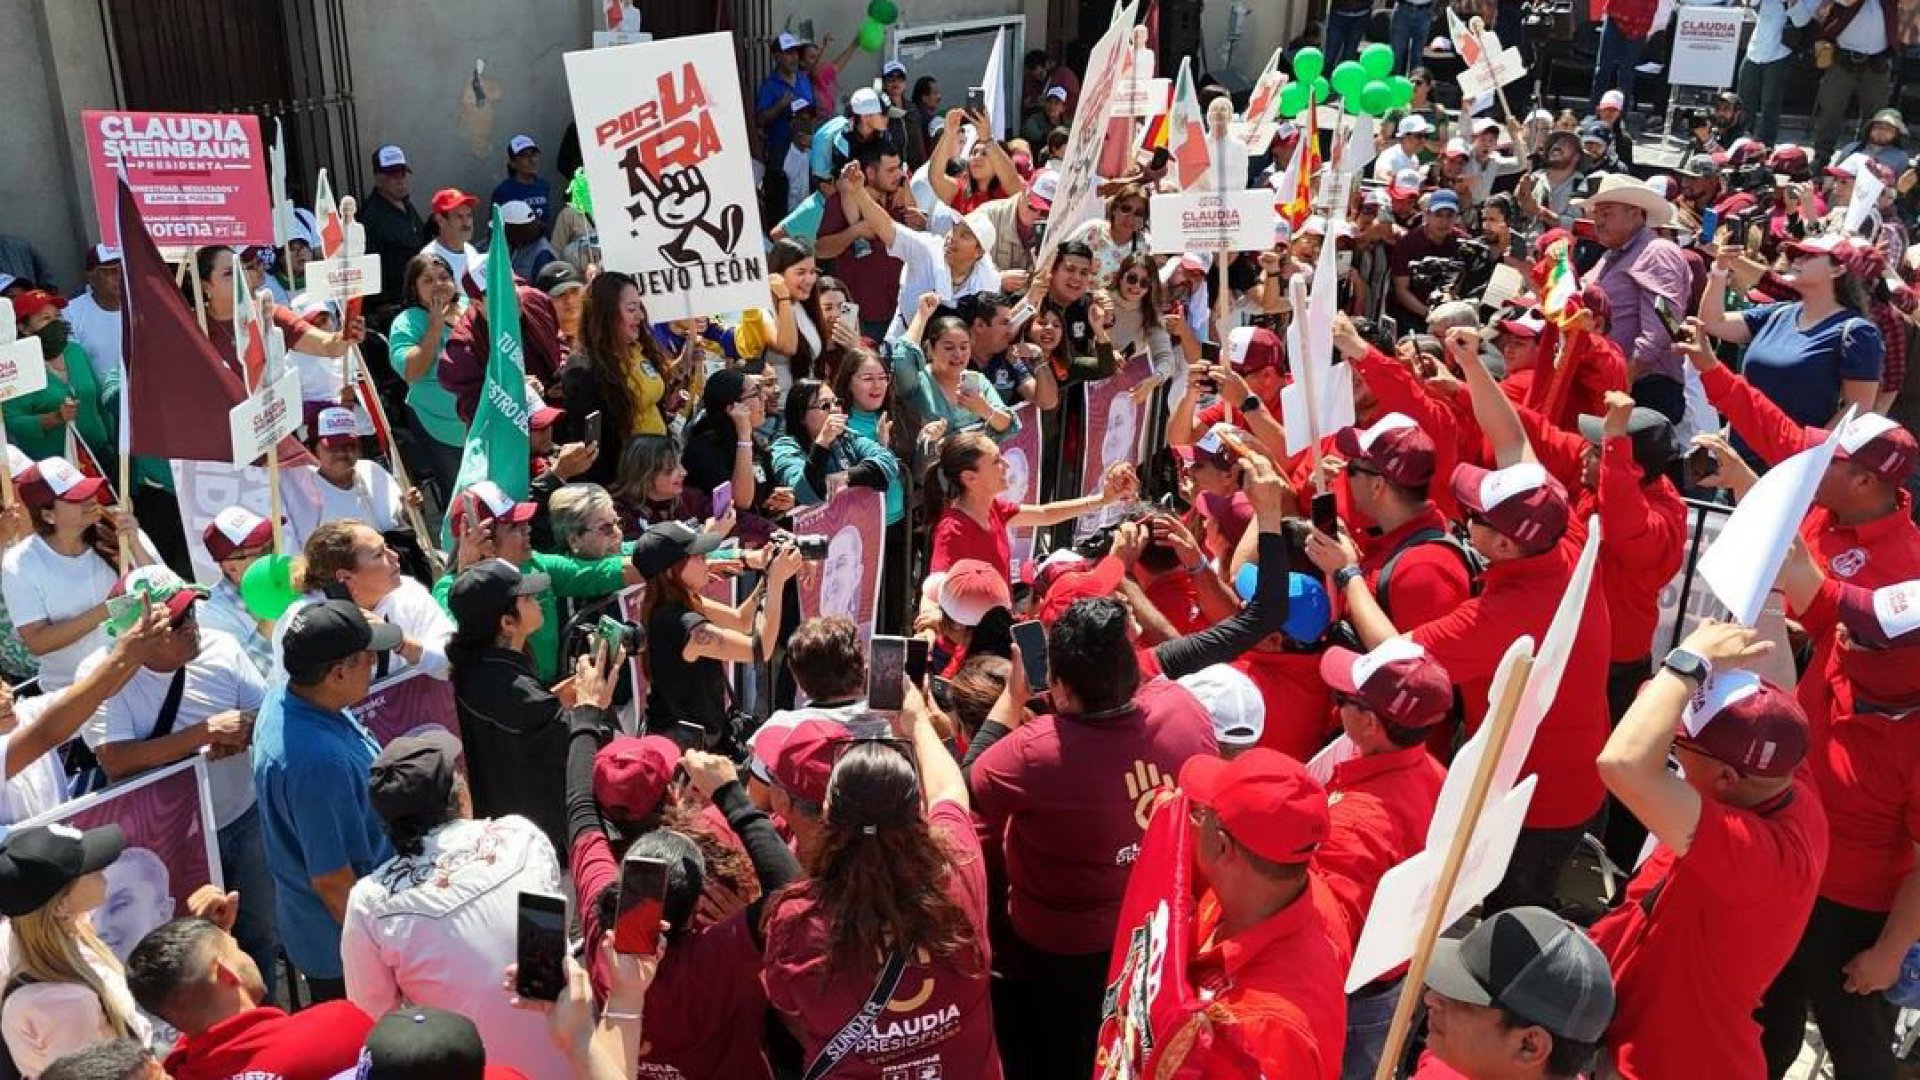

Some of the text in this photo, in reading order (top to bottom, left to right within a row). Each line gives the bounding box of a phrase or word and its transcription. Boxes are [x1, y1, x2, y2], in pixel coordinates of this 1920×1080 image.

[1681, 20, 1736, 31] CLAUDIA
[596, 61, 706, 147] POR LA
[100, 116, 248, 141] CLAUDIA
[103, 139, 250, 158] SHEINBAUM
[136, 161, 223, 170] PRESIDENTA
[1182, 209, 1239, 221] CLAUDIA
[701, 253, 761, 287] LEÓN
[827, 1002, 883, 1062] SUNDAR
